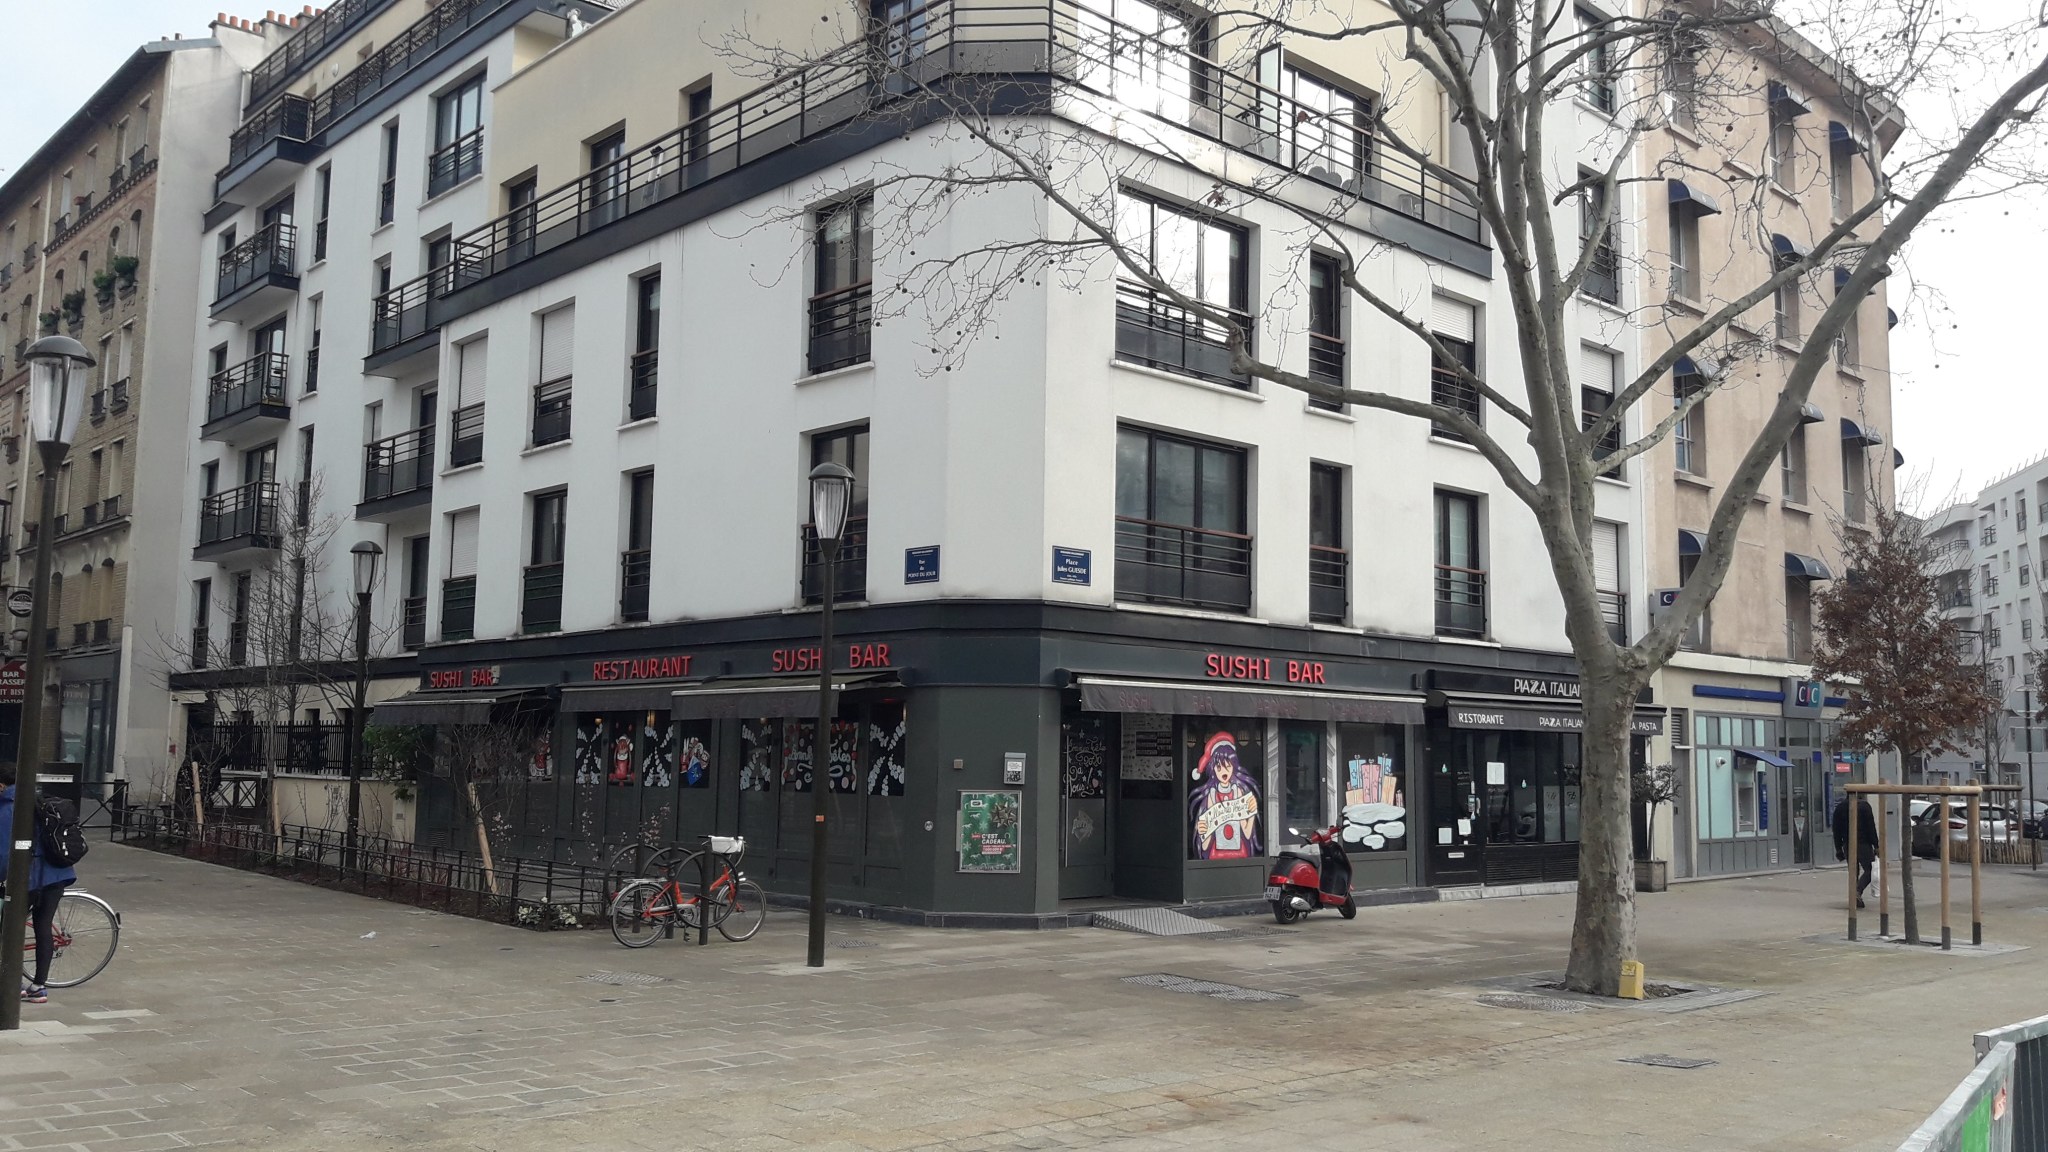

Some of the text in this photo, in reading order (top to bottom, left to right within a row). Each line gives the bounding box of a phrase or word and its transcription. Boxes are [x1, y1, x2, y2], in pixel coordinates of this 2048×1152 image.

[1065, 558, 1079, 566] Place
[1068, 566, 1087, 575] GUESDE
[771, 643, 890, 673] SUSH BAR
[593, 655, 693, 681] RESTAURANT
[1206, 654, 1326, 684] SUSHI BAR
[430, 668, 494, 688] SUSHI BAR
[1514, 678, 1547, 695] PIAZZA
[1798, 685, 1818, 704] CIC
[1458, 713, 1504, 725] RISTORANTE
[1538, 716, 1562, 728] PIAZZA
[1638, 721, 1657, 731] PASTA
